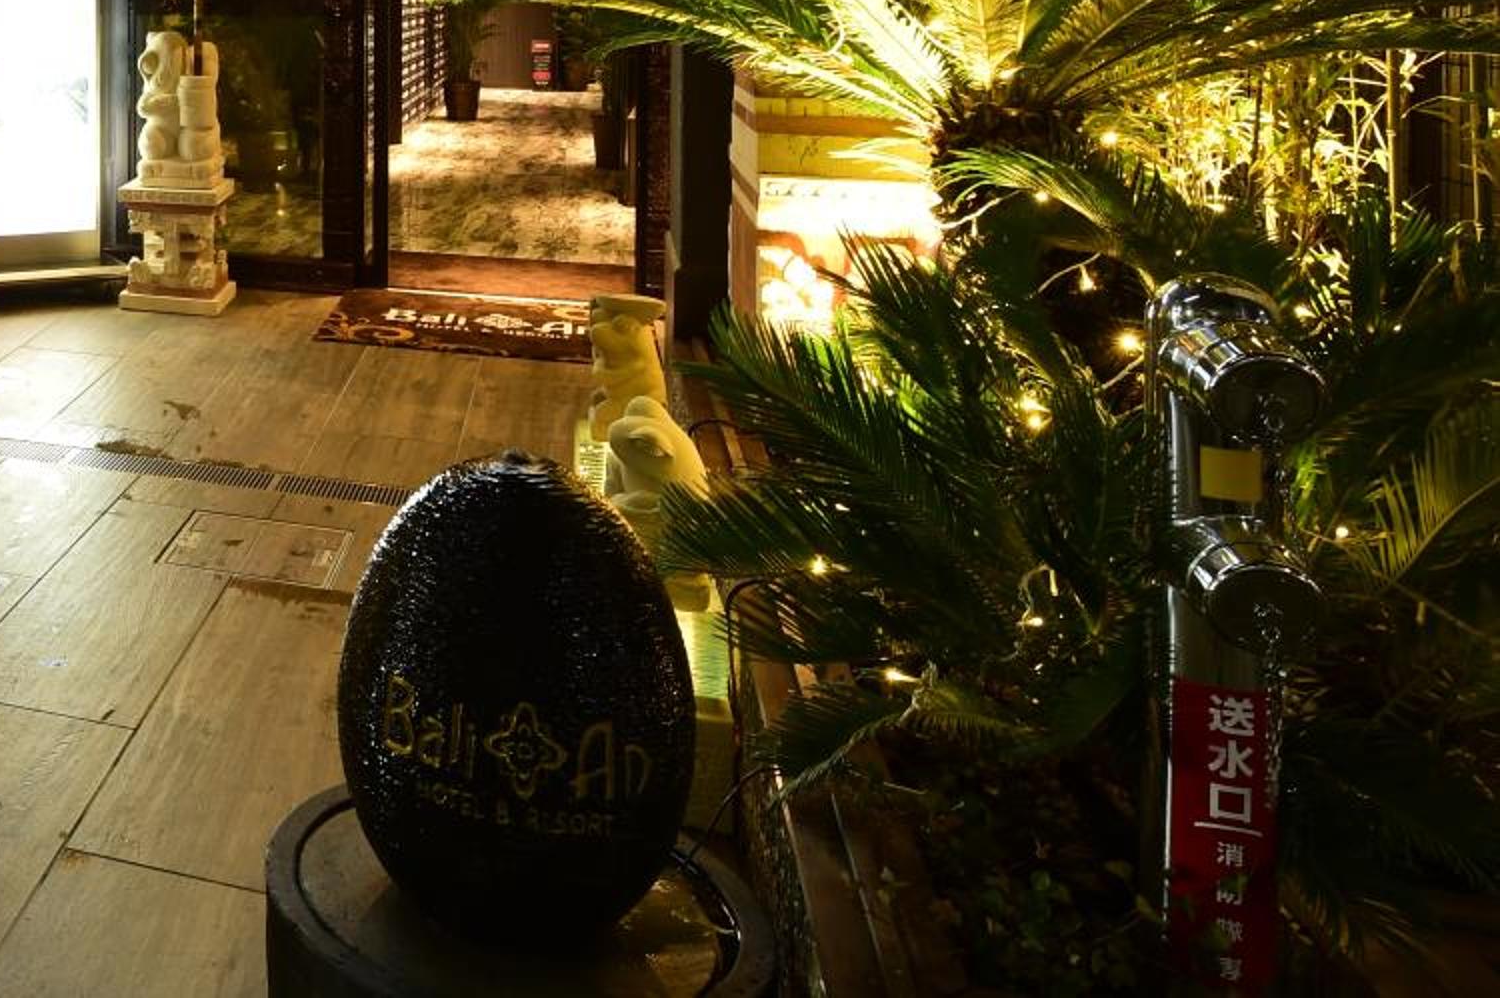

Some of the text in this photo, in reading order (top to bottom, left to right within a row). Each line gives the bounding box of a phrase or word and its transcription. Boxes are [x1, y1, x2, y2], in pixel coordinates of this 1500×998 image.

[381, 307, 468, 326] Bali
[382, 669, 653, 800] Bali An
[1207, 693, 1256, 824] 送水口
